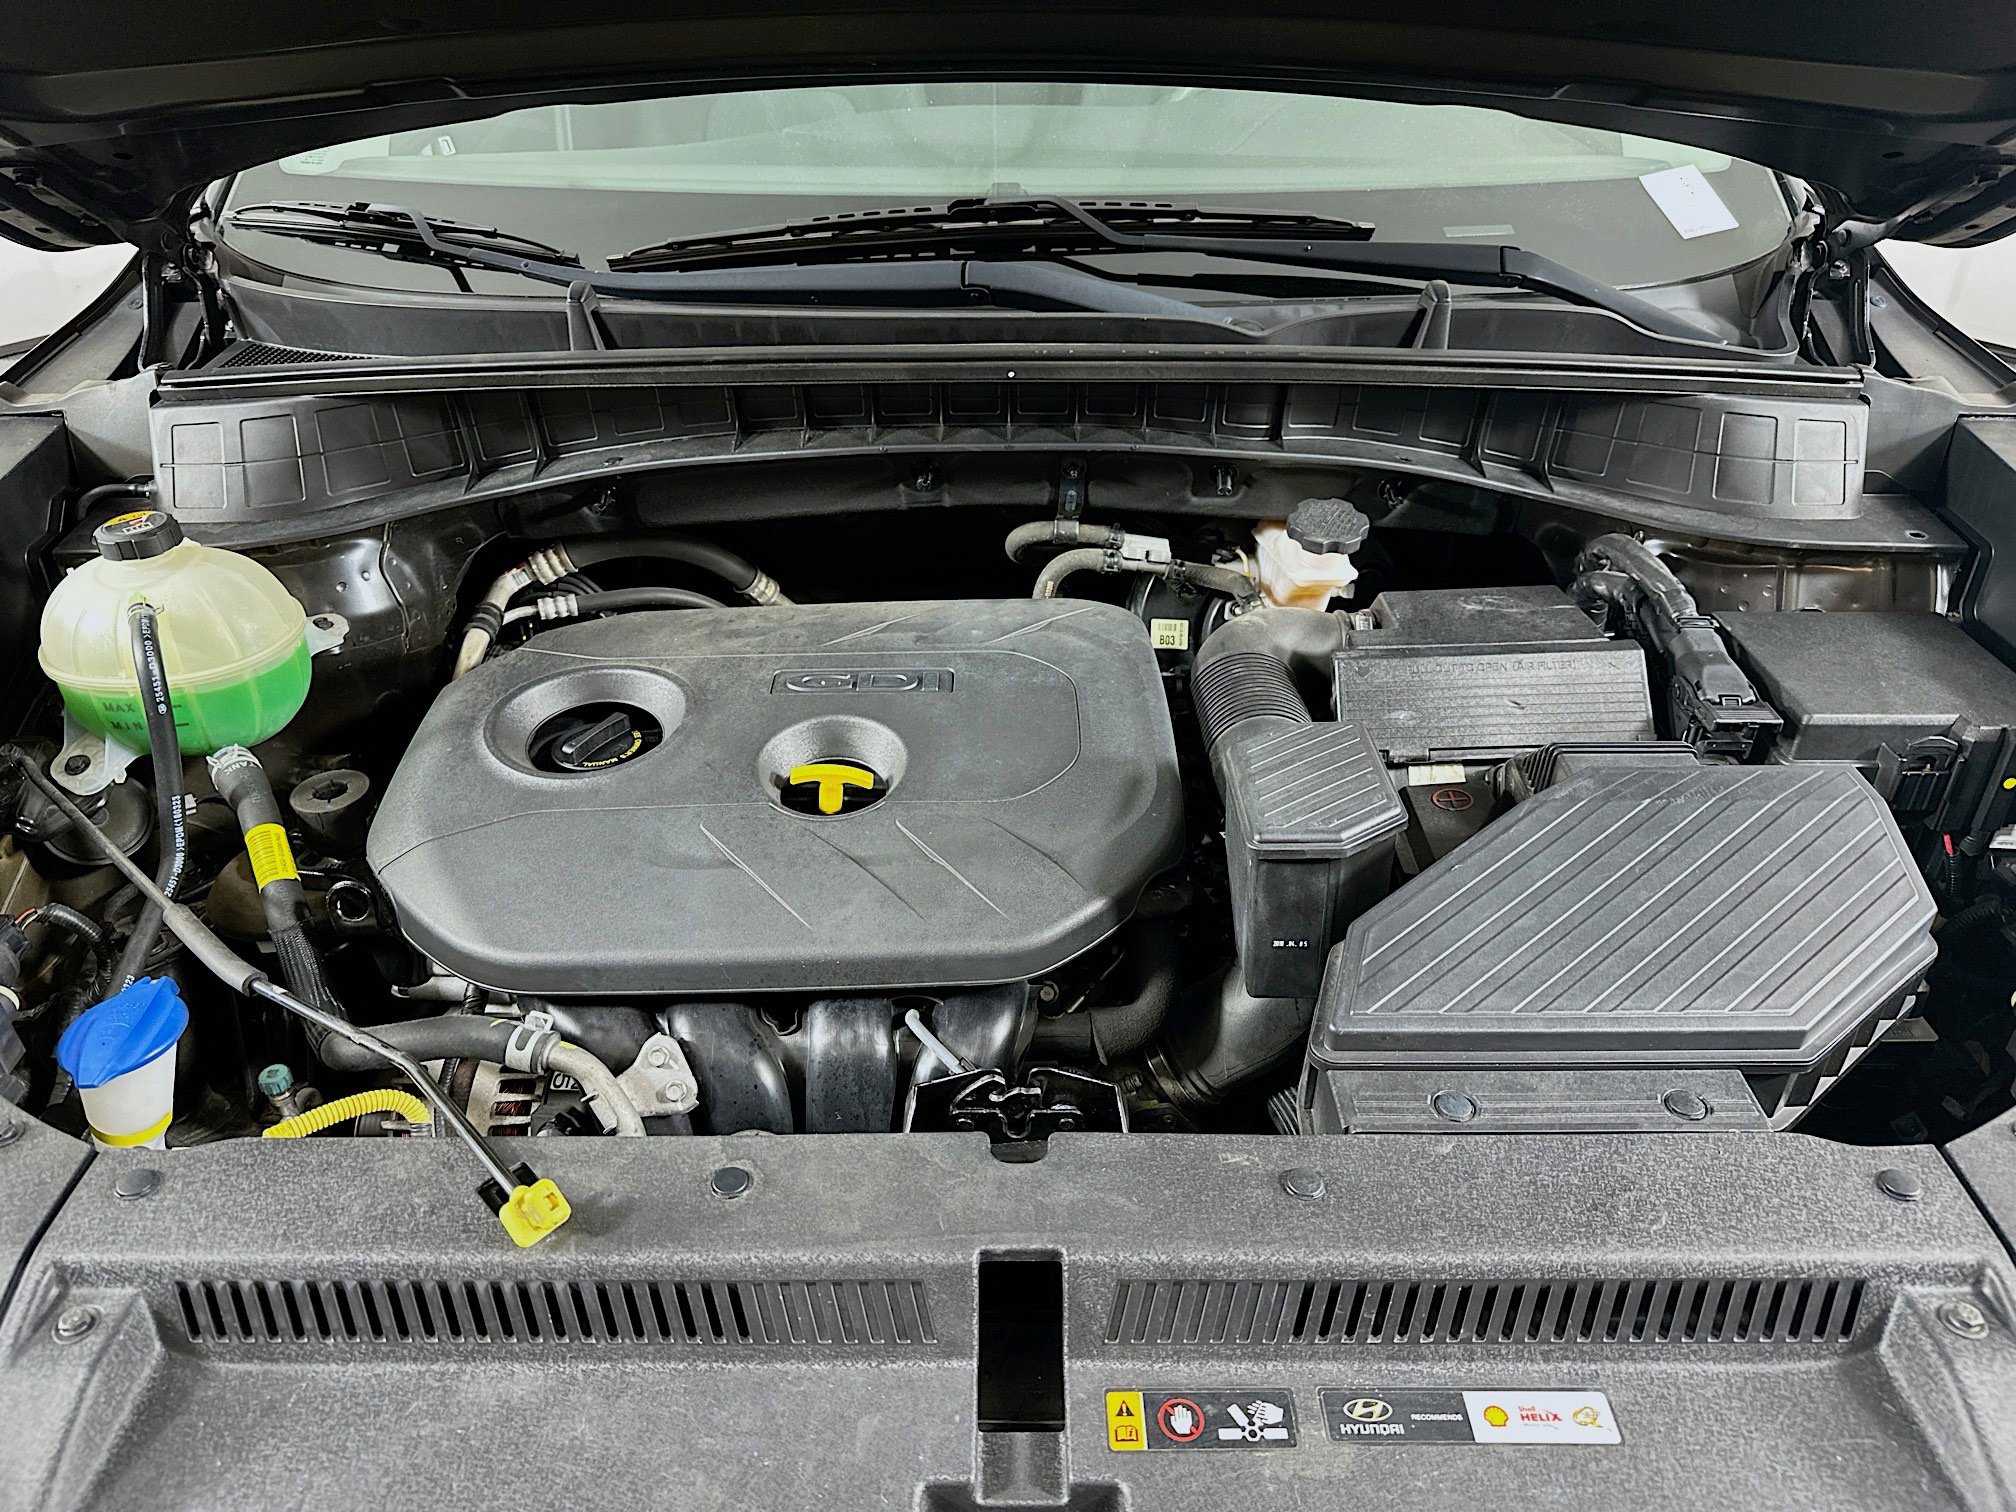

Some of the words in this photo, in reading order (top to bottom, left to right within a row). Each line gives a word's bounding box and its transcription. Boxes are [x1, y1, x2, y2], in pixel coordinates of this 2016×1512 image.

[1160, 635, 1175, 646] B03
[1477, 661, 1508, 672] OPEN
[786, 671, 940, 692] GDI
[102, 702, 135, 713] MAX
[110, 720, 144, 731] MIN
[1410, 1413, 1463, 1421] RECOMMENDS
[1519, 1410, 1563, 1422] HELIX
[1339, 1423, 1405, 1436] HYUNDAI
